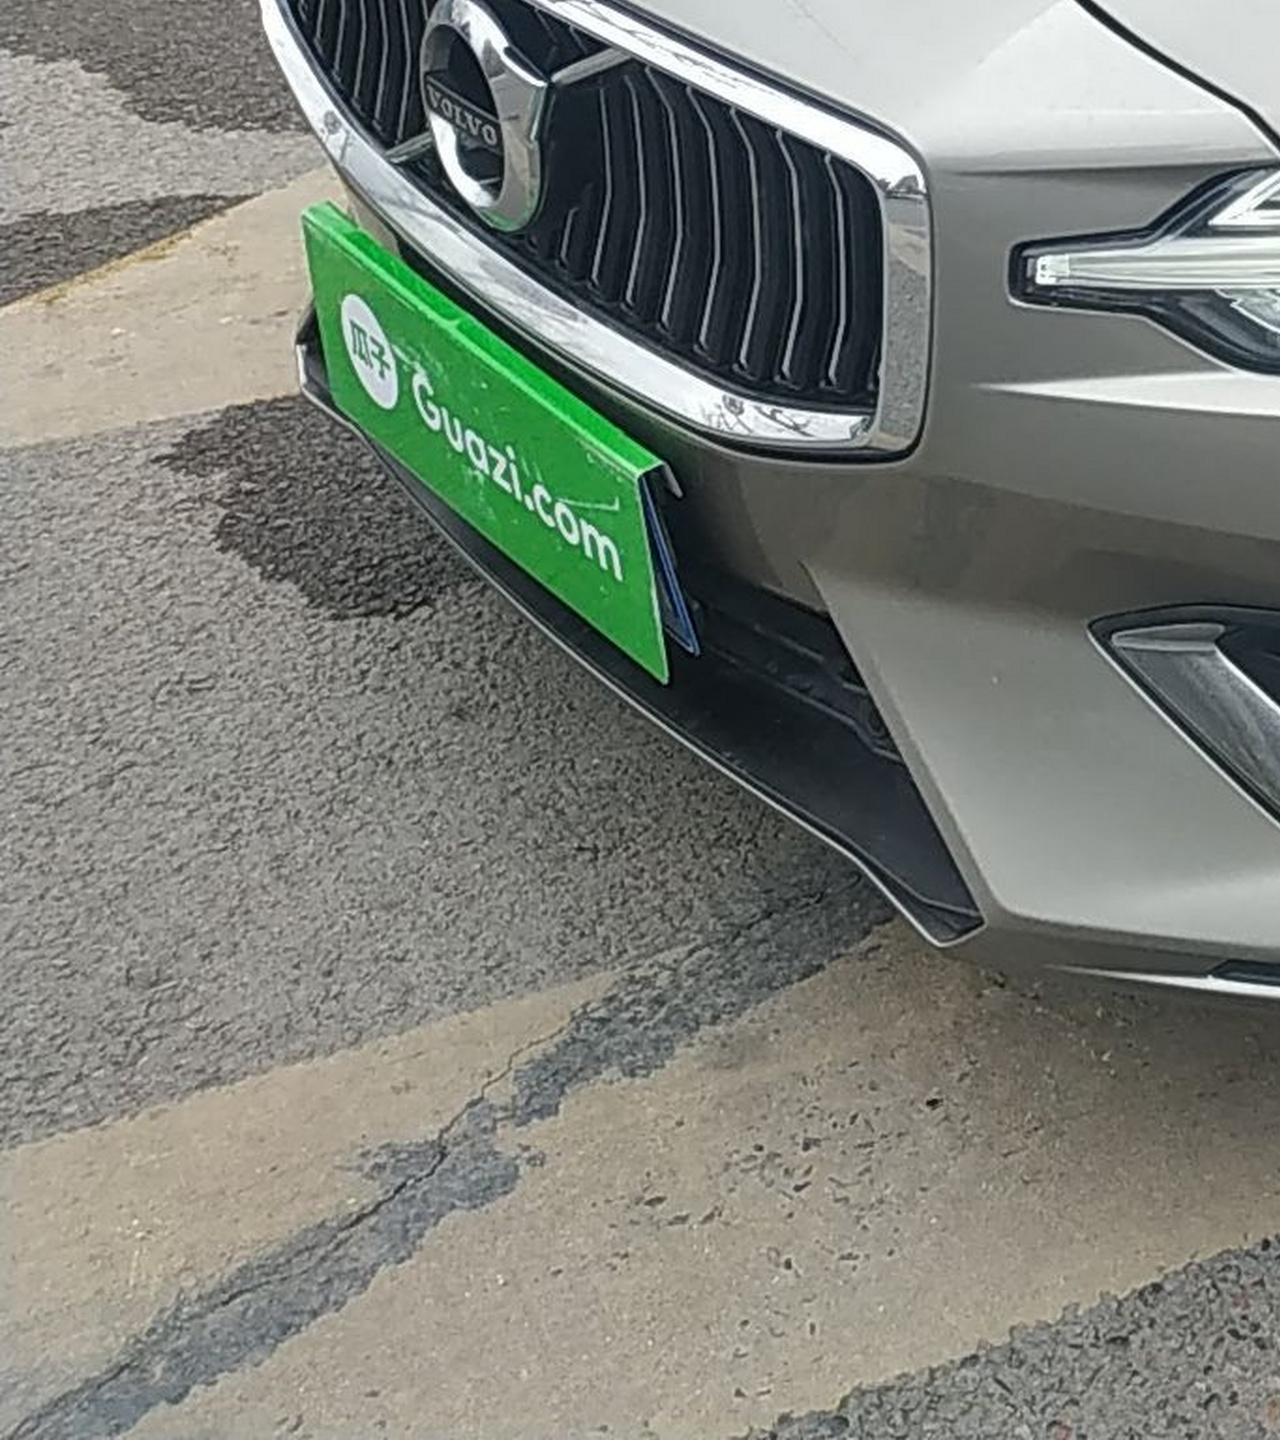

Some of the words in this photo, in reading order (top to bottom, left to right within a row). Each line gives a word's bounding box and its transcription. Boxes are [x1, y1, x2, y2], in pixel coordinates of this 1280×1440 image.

[426, 83, 498, 147] VOLVO
[350, 318, 391, 381] 瓜子
[412, 371, 624, 582] Guazi.com
